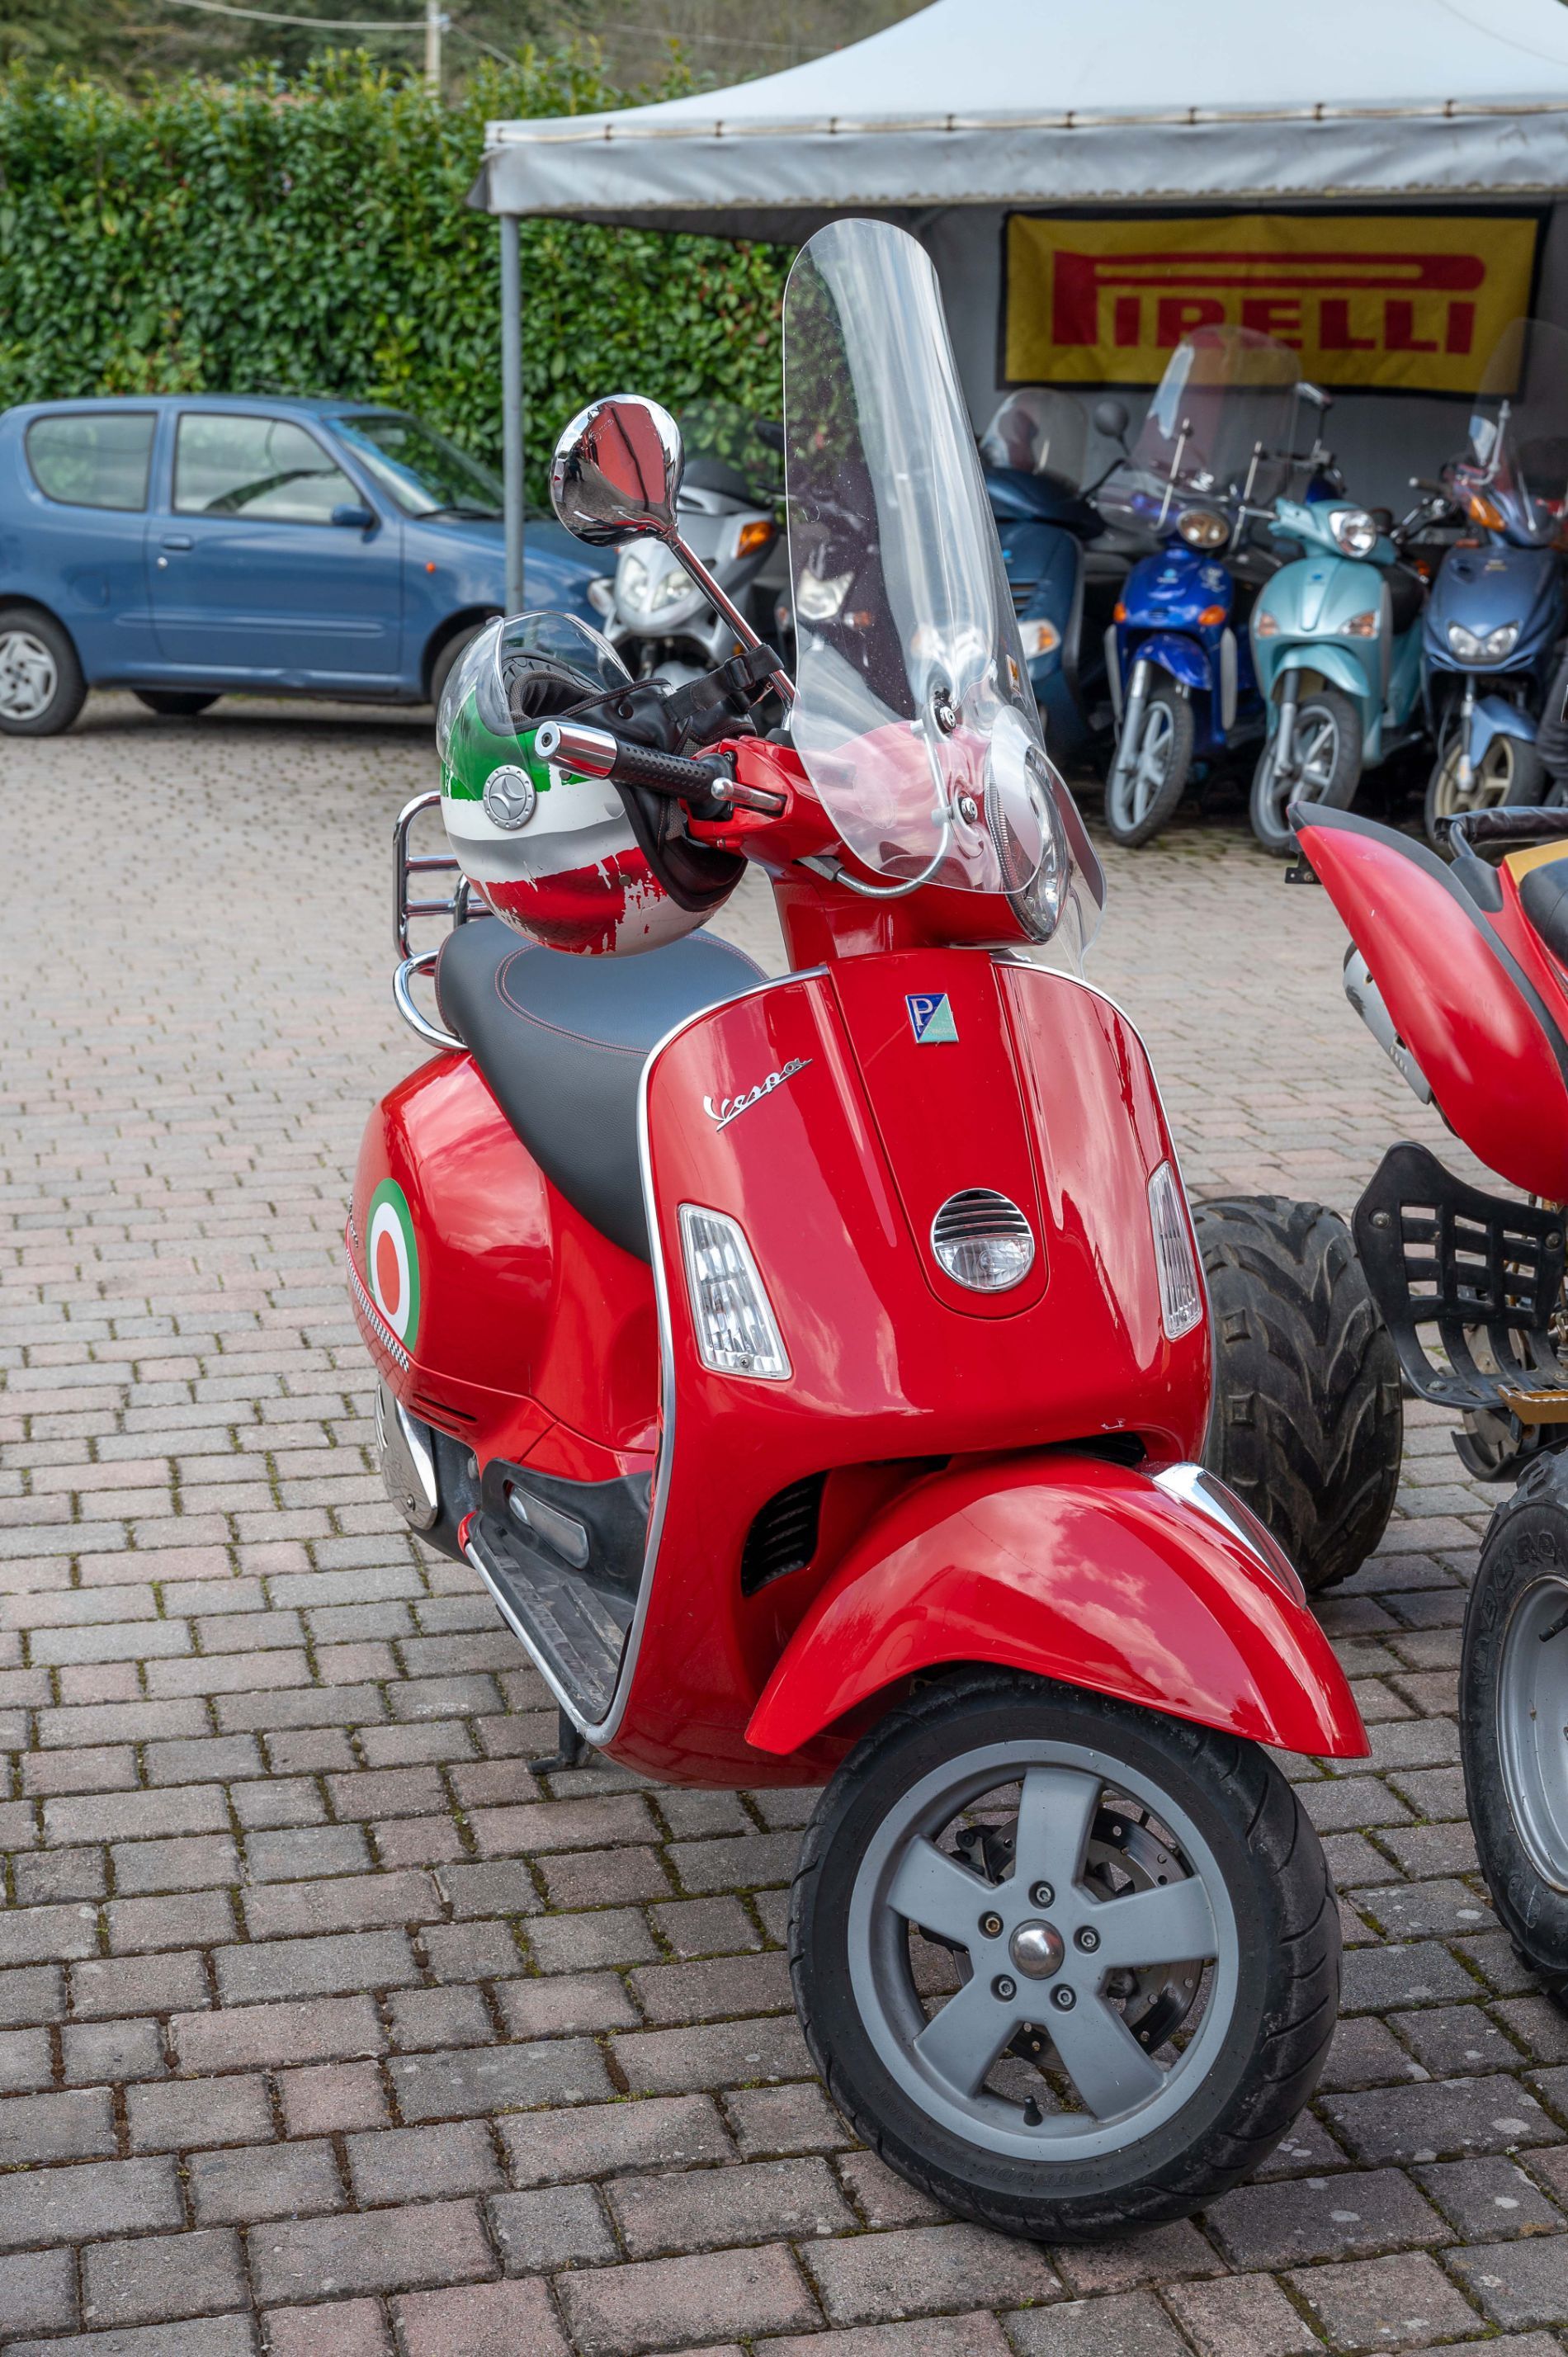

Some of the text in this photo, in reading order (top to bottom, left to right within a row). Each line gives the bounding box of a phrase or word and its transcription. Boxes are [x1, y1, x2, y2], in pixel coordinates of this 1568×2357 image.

[1051, 250, 1486, 355] PIRELLI
[909, 998, 933, 1027] P
[703, 1057, 813, 1132] Vespa
[976, 2163, 1096, 2188] DUNLOP
